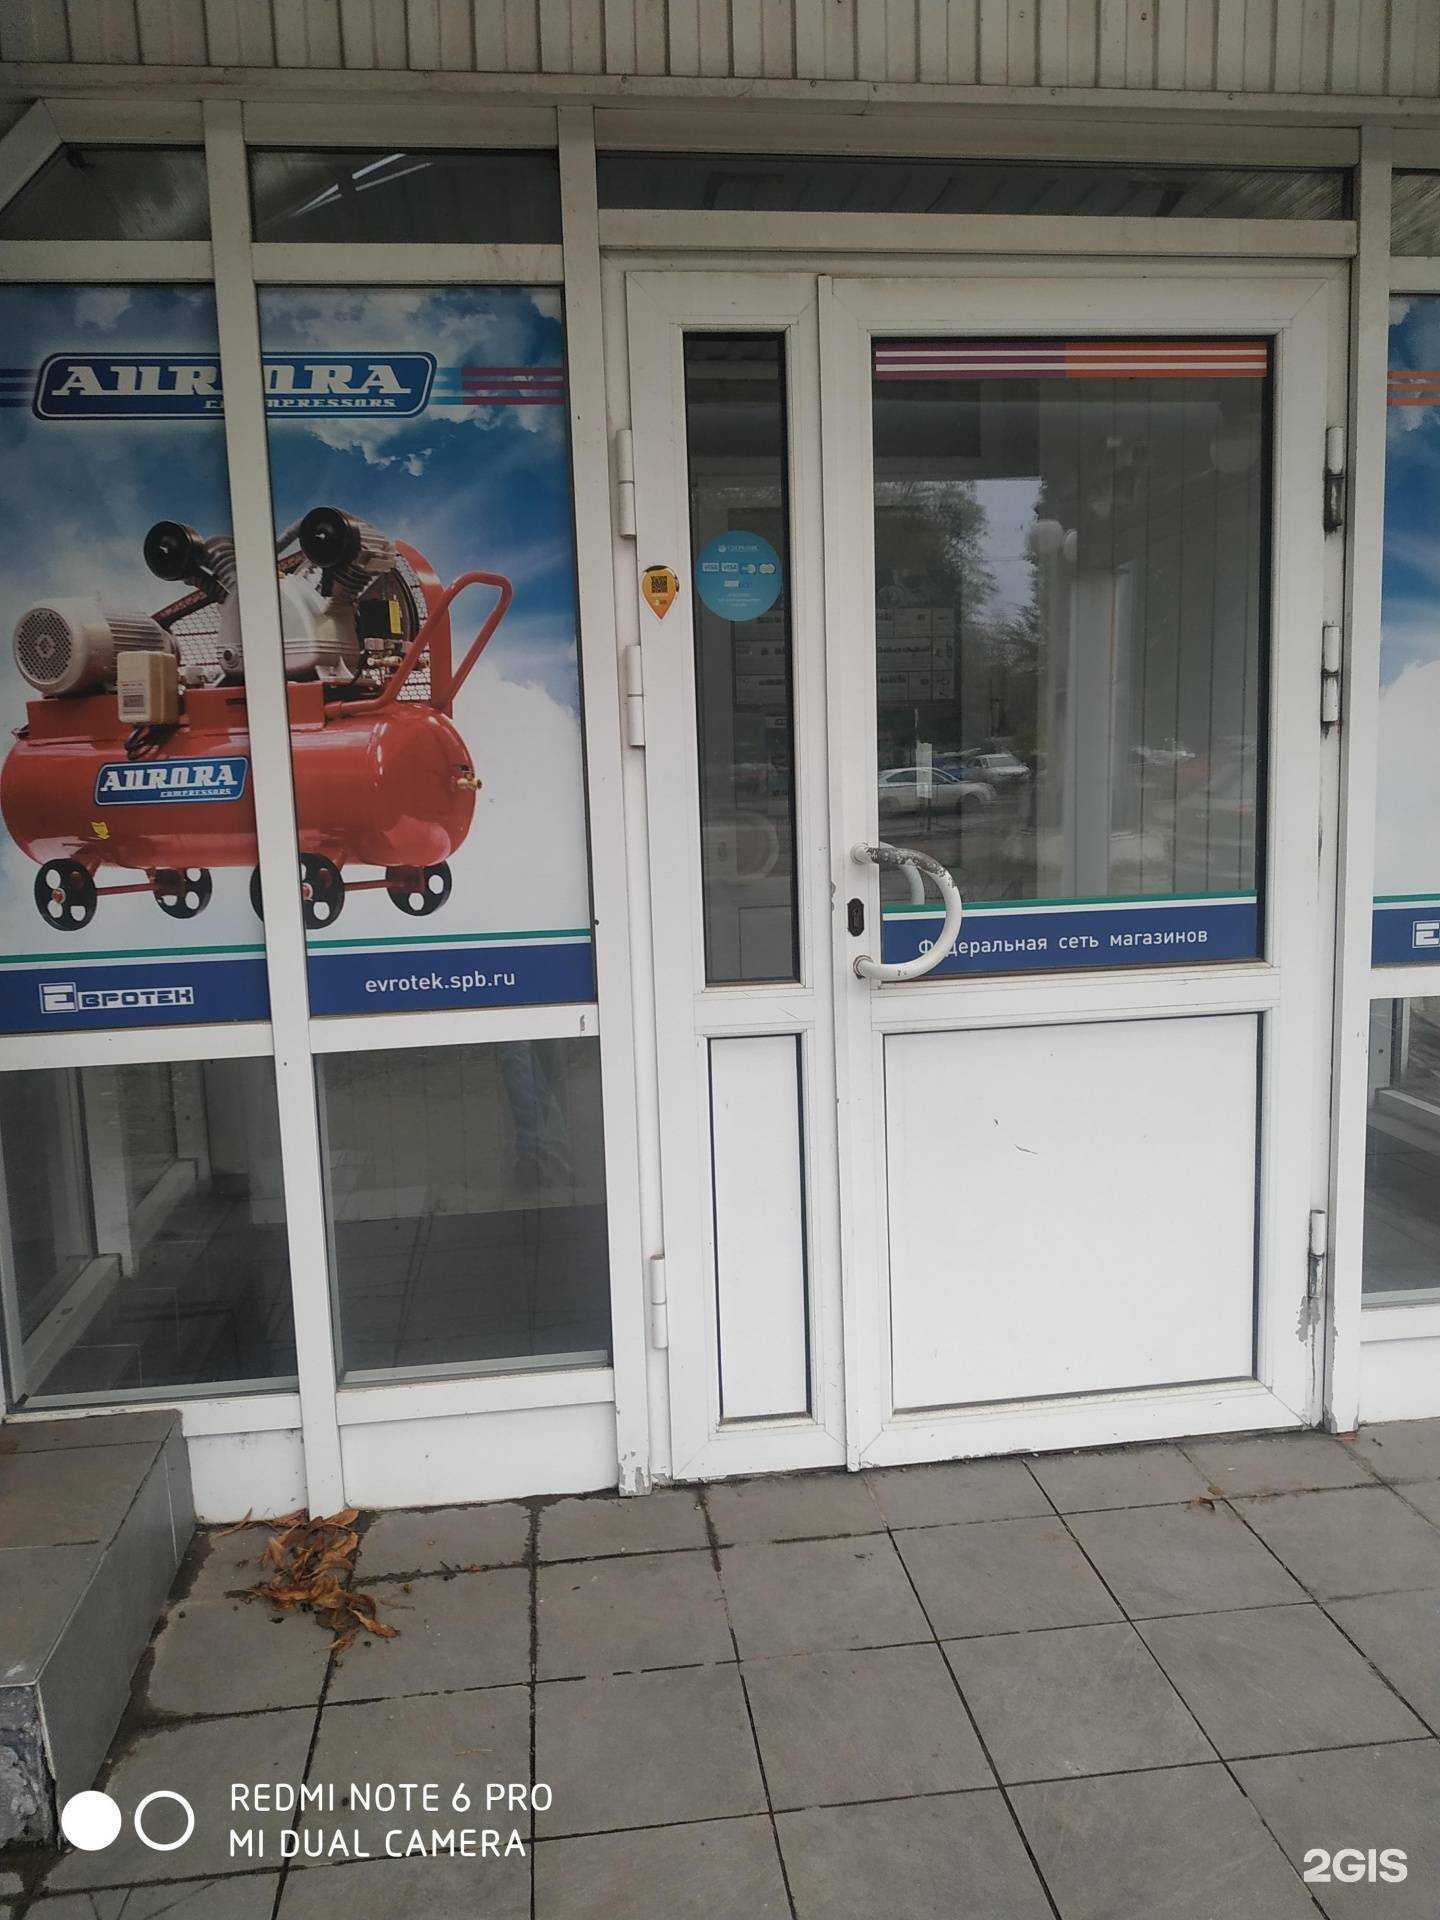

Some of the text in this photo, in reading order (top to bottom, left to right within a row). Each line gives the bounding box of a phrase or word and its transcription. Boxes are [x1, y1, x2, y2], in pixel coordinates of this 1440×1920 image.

[203, 398, 397, 410] CMPRESSORS
[100, 765, 238, 792] AURORA
[918, 930, 1208, 958] Фдеральная сеть магазинов
[365, 970, 516, 993] evrotek.spb.ru
